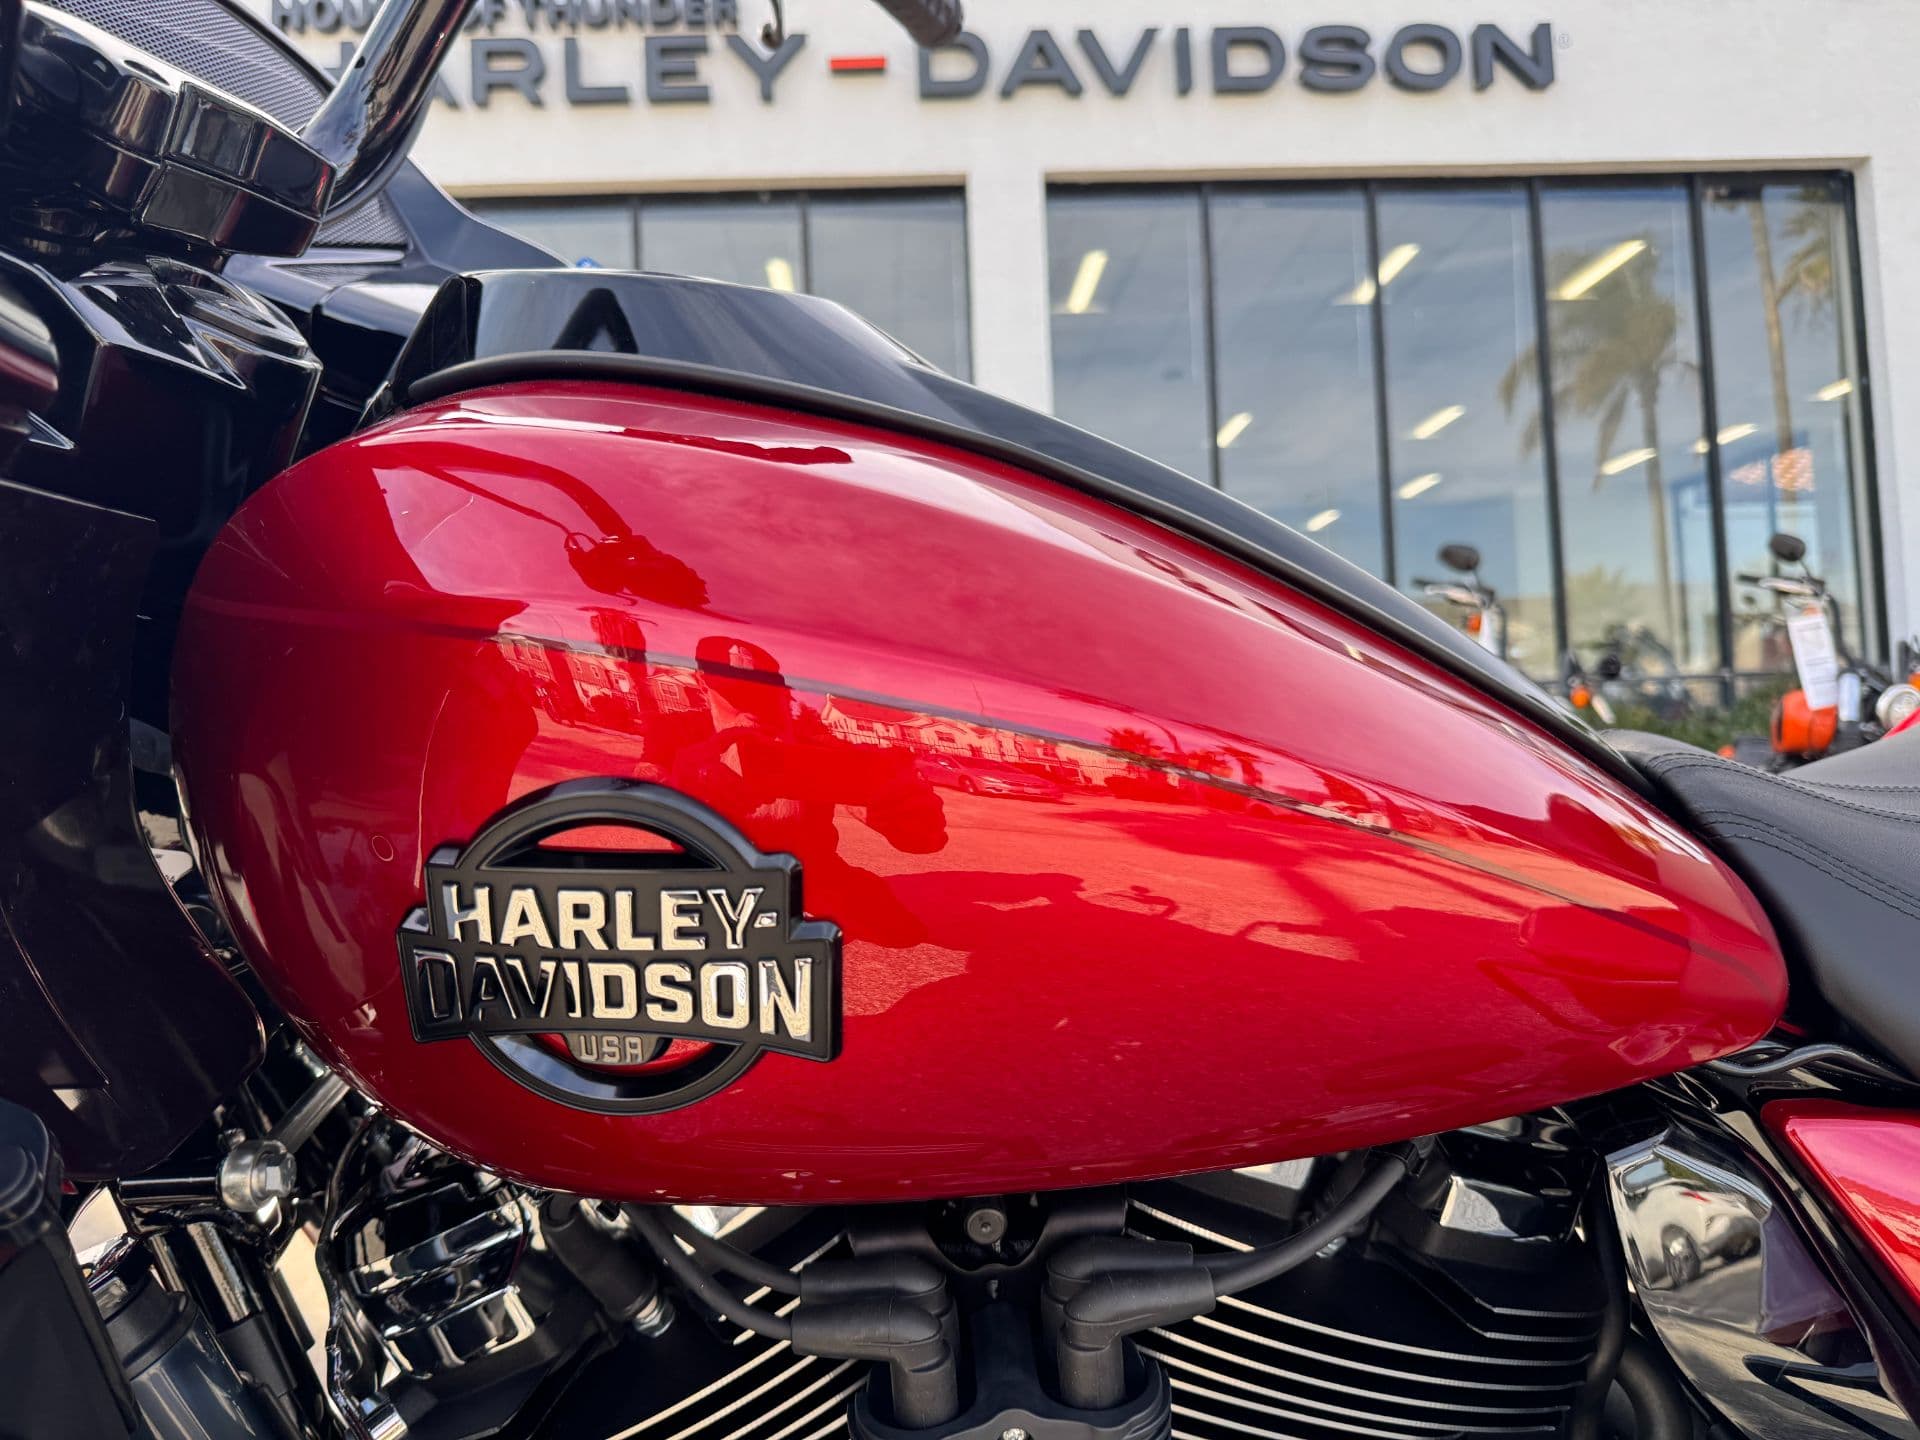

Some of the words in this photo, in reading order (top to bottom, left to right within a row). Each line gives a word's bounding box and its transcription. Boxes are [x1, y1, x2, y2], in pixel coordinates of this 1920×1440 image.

[271, 0, 384, 33] HOU
[442, 883, 778, 951] HARLEY-
[413, 946, 813, 1043] DAVIDSON
[577, 1034, 645, 1064] USA
